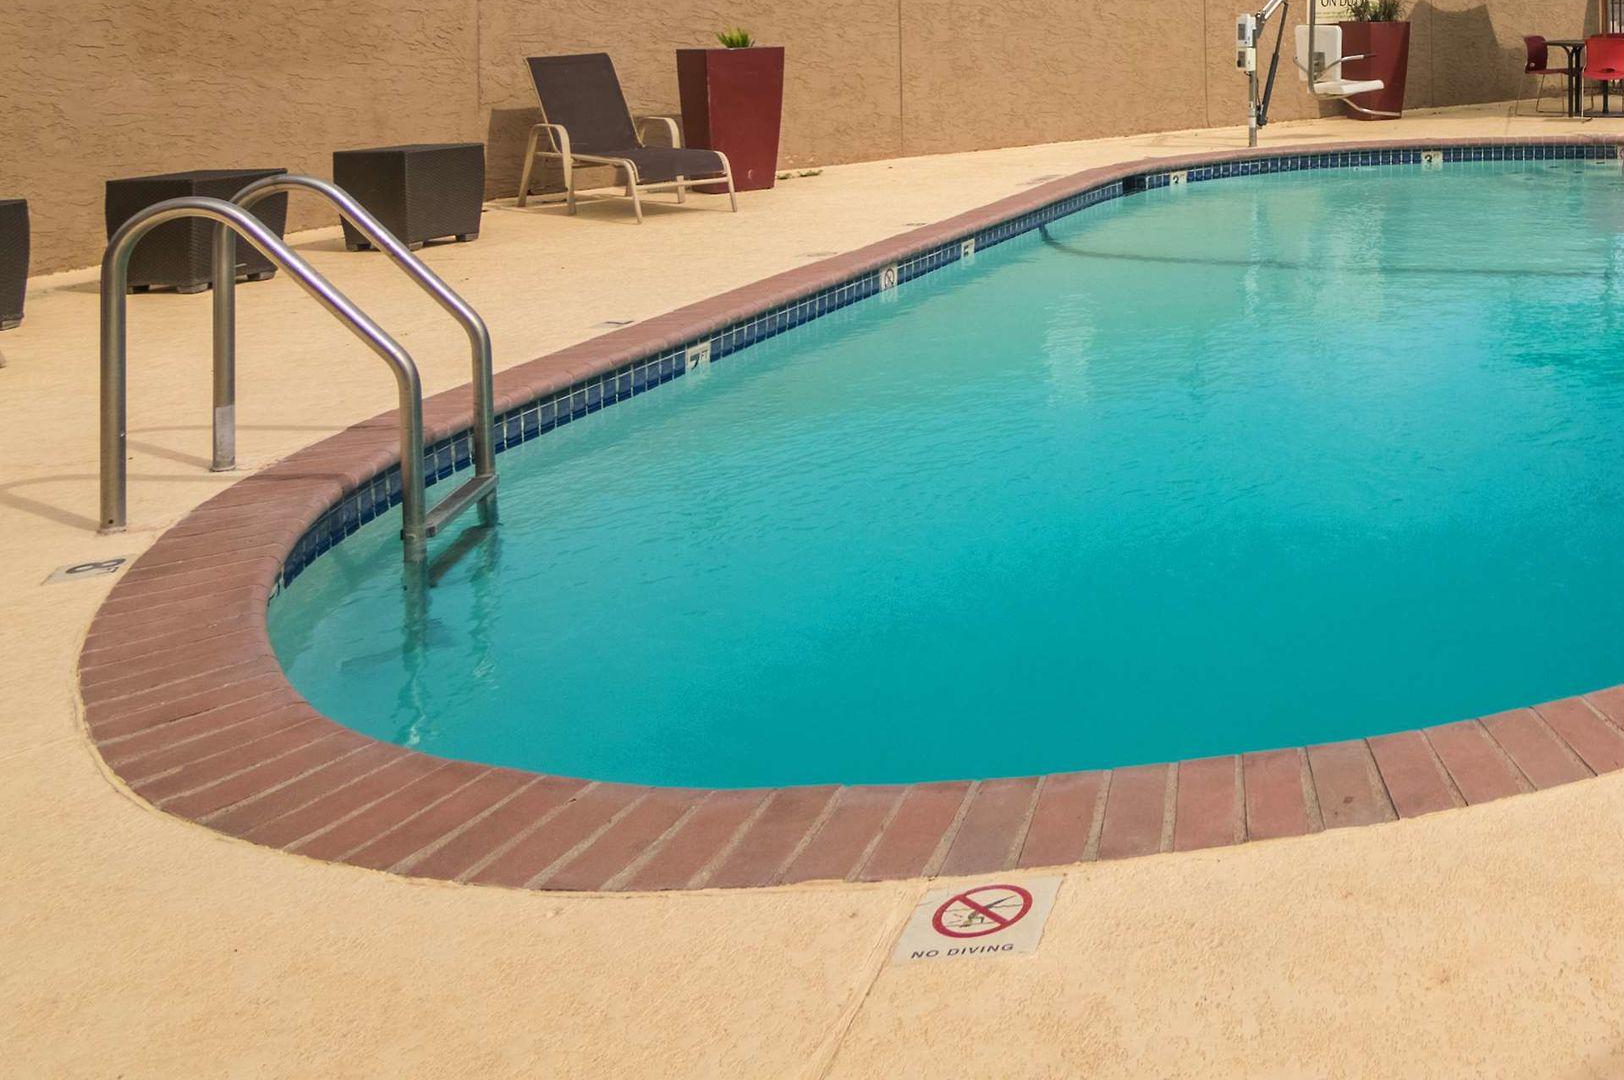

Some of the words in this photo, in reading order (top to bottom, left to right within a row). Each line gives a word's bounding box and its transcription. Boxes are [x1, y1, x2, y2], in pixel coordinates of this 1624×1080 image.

[690, 352, 700, 370] 7
[701, 349, 709, 360] FT
[910, 949, 940, 959] NO
[946, 943, 1015, 956] DIVING
